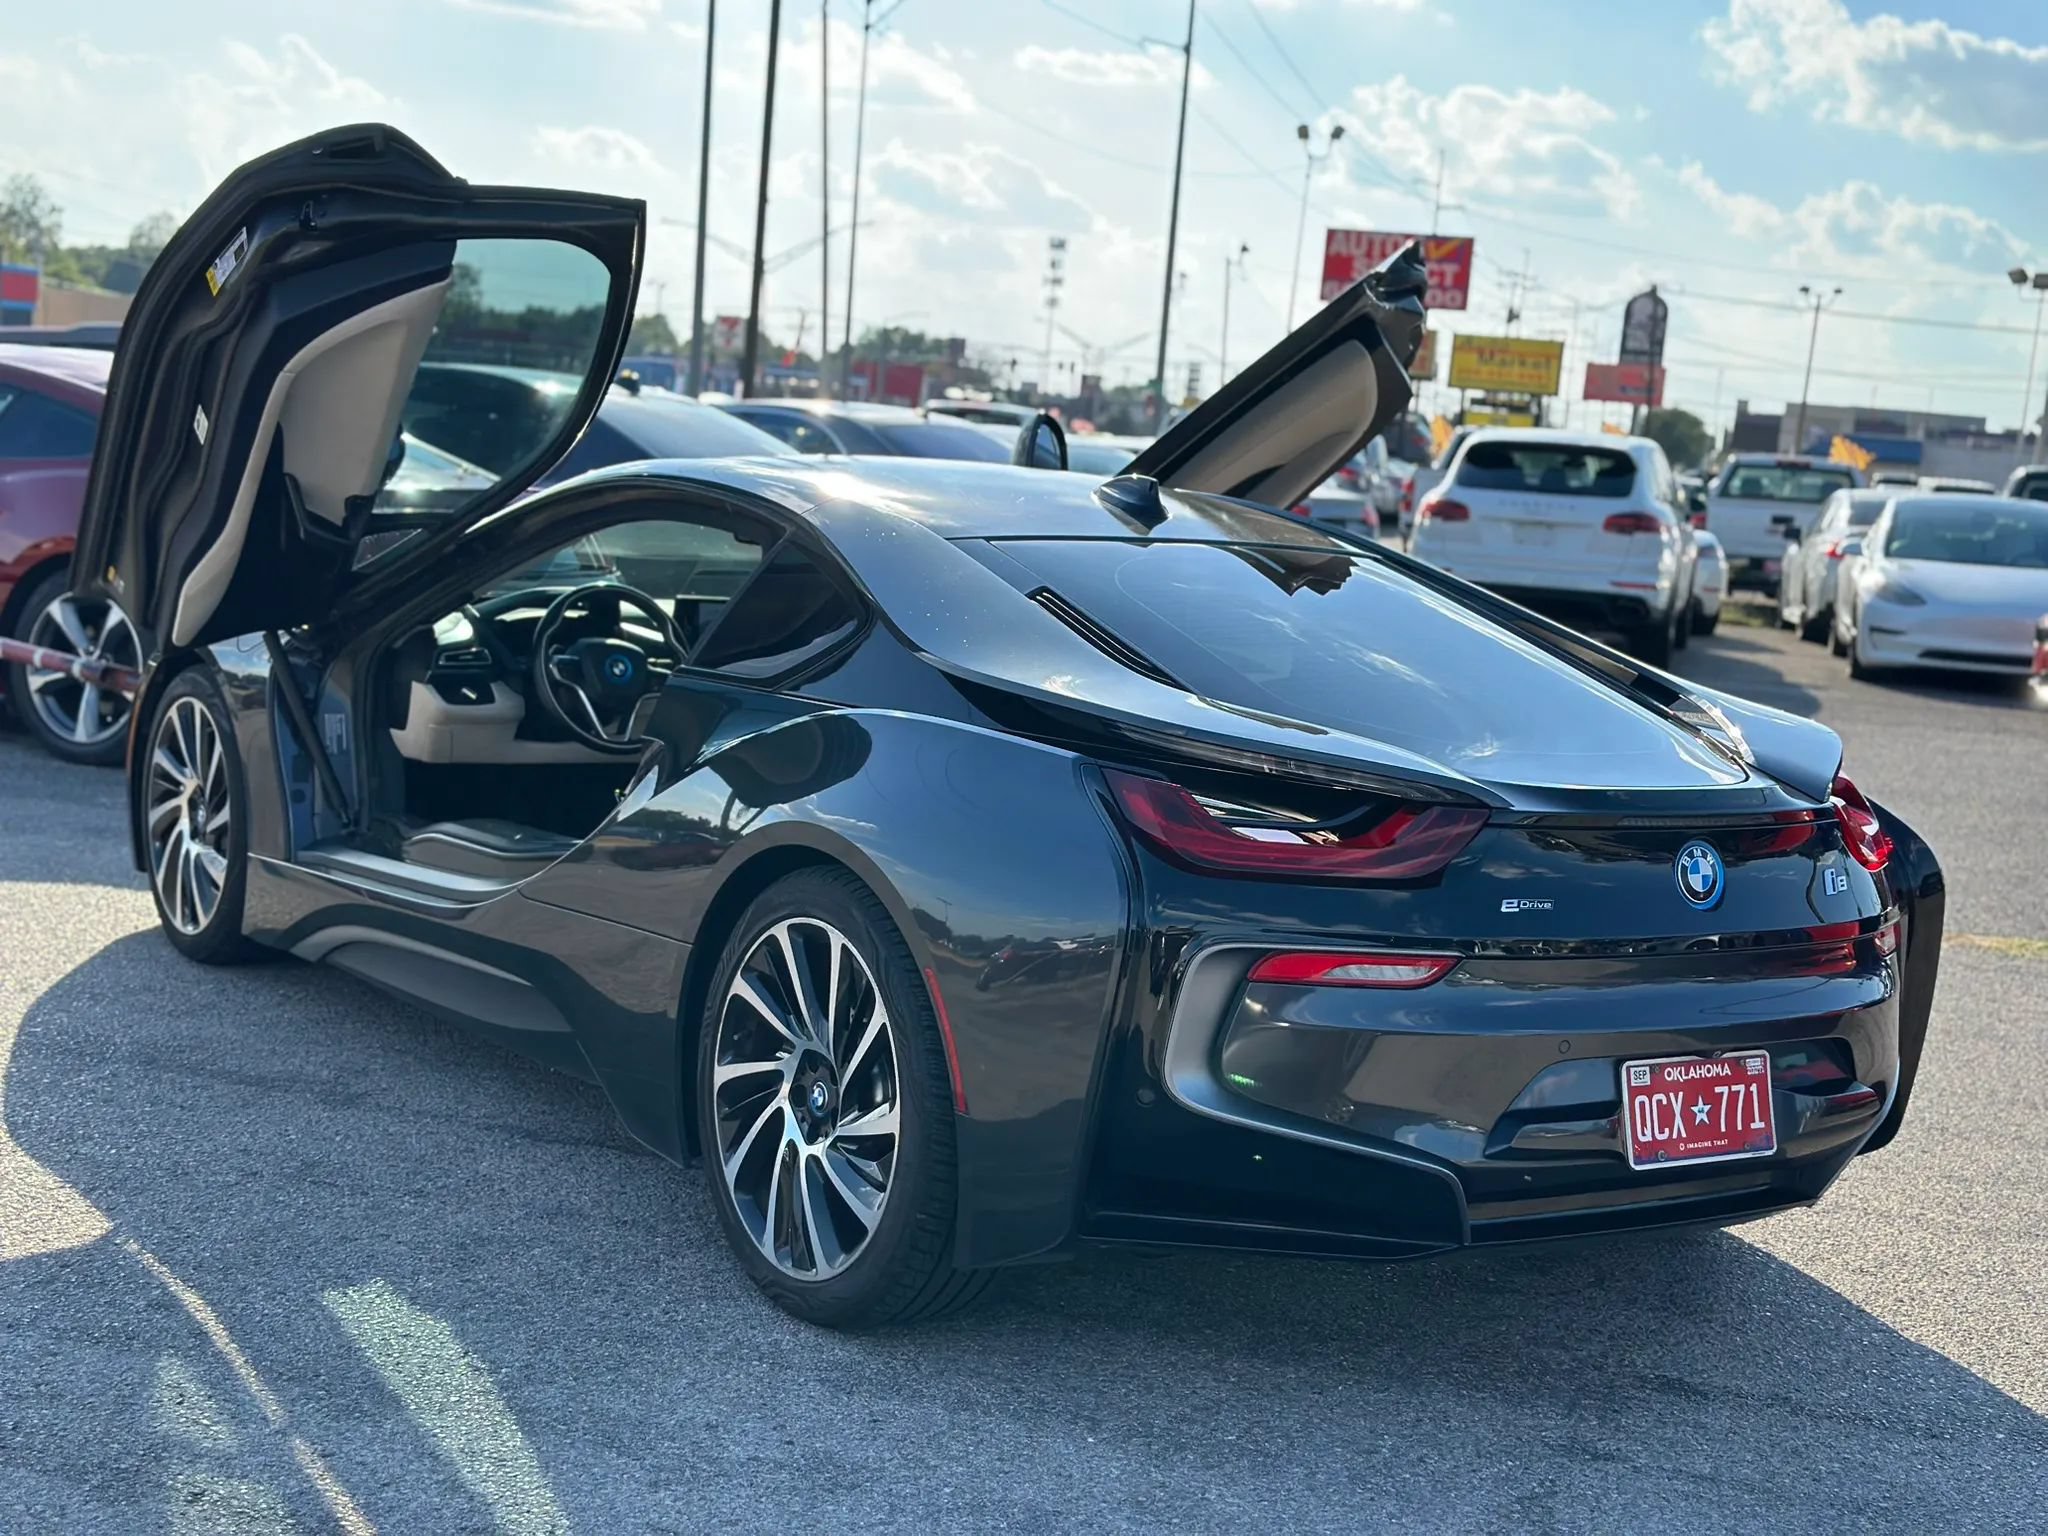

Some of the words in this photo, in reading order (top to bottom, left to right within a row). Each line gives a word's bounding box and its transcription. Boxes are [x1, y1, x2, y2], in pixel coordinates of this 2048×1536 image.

[1682, 848, 1714, 867] BMW
[1824, 868, 1848, 896] i8
[1633, 1070, 1648, 1081] SEP
[1664, 1063, 1731, 1082] OKLAHOMA
[1634, 1091, 1687, 1142] QCX
[1714, 1082, 1765, 1132] 771
[1686, 1141, 1712, 1149] IMAGINE
[1713, 1139, 1728, 1147] THAT
